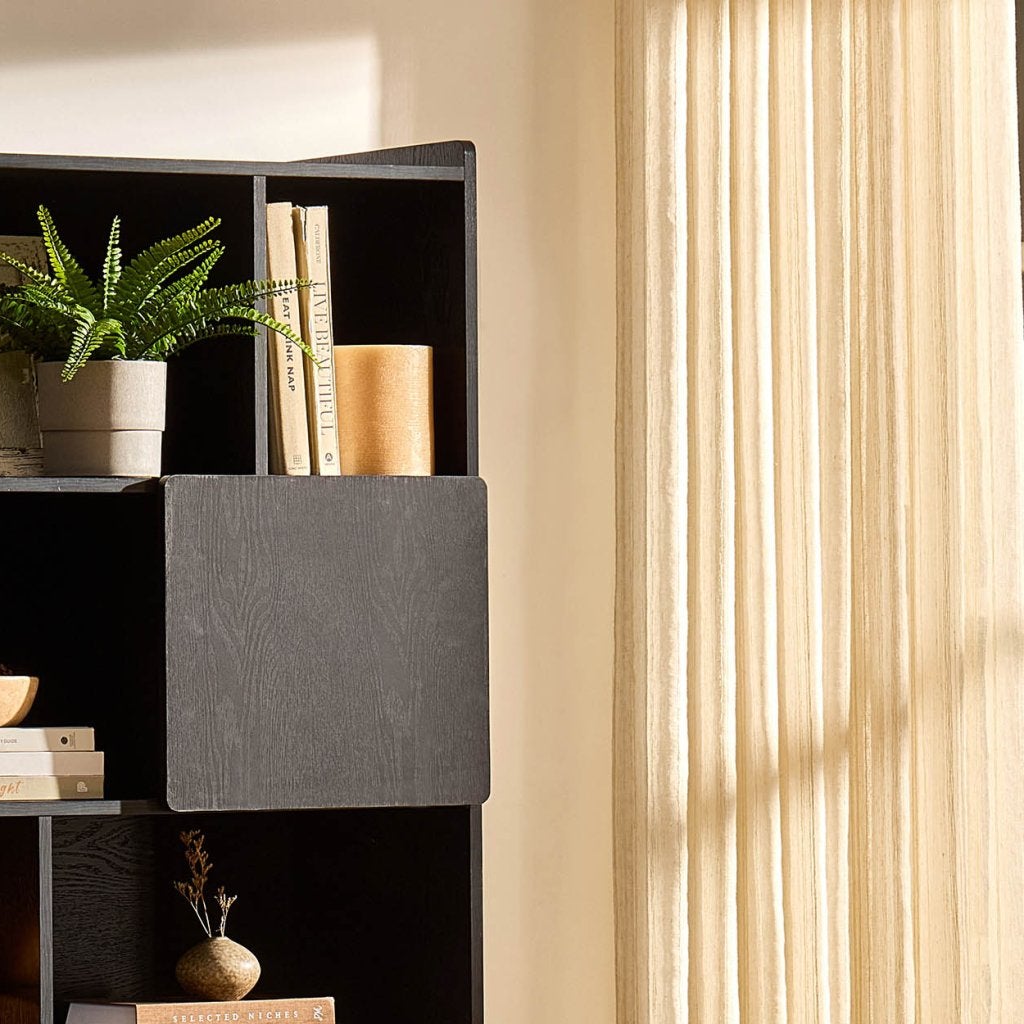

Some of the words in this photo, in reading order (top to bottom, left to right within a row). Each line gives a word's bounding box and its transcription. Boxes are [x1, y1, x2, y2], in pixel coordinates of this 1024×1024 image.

[313, 282, 328, 324] LIVE
[282, 297, 291, 319] EAT
[287, 366, 296, 392] NAP
[315, 330, 334, 436] BEAUTIFUL
[172, 1012, 239, 1023] SELECTED
[248, 1010, 299, 1020] NICHES
